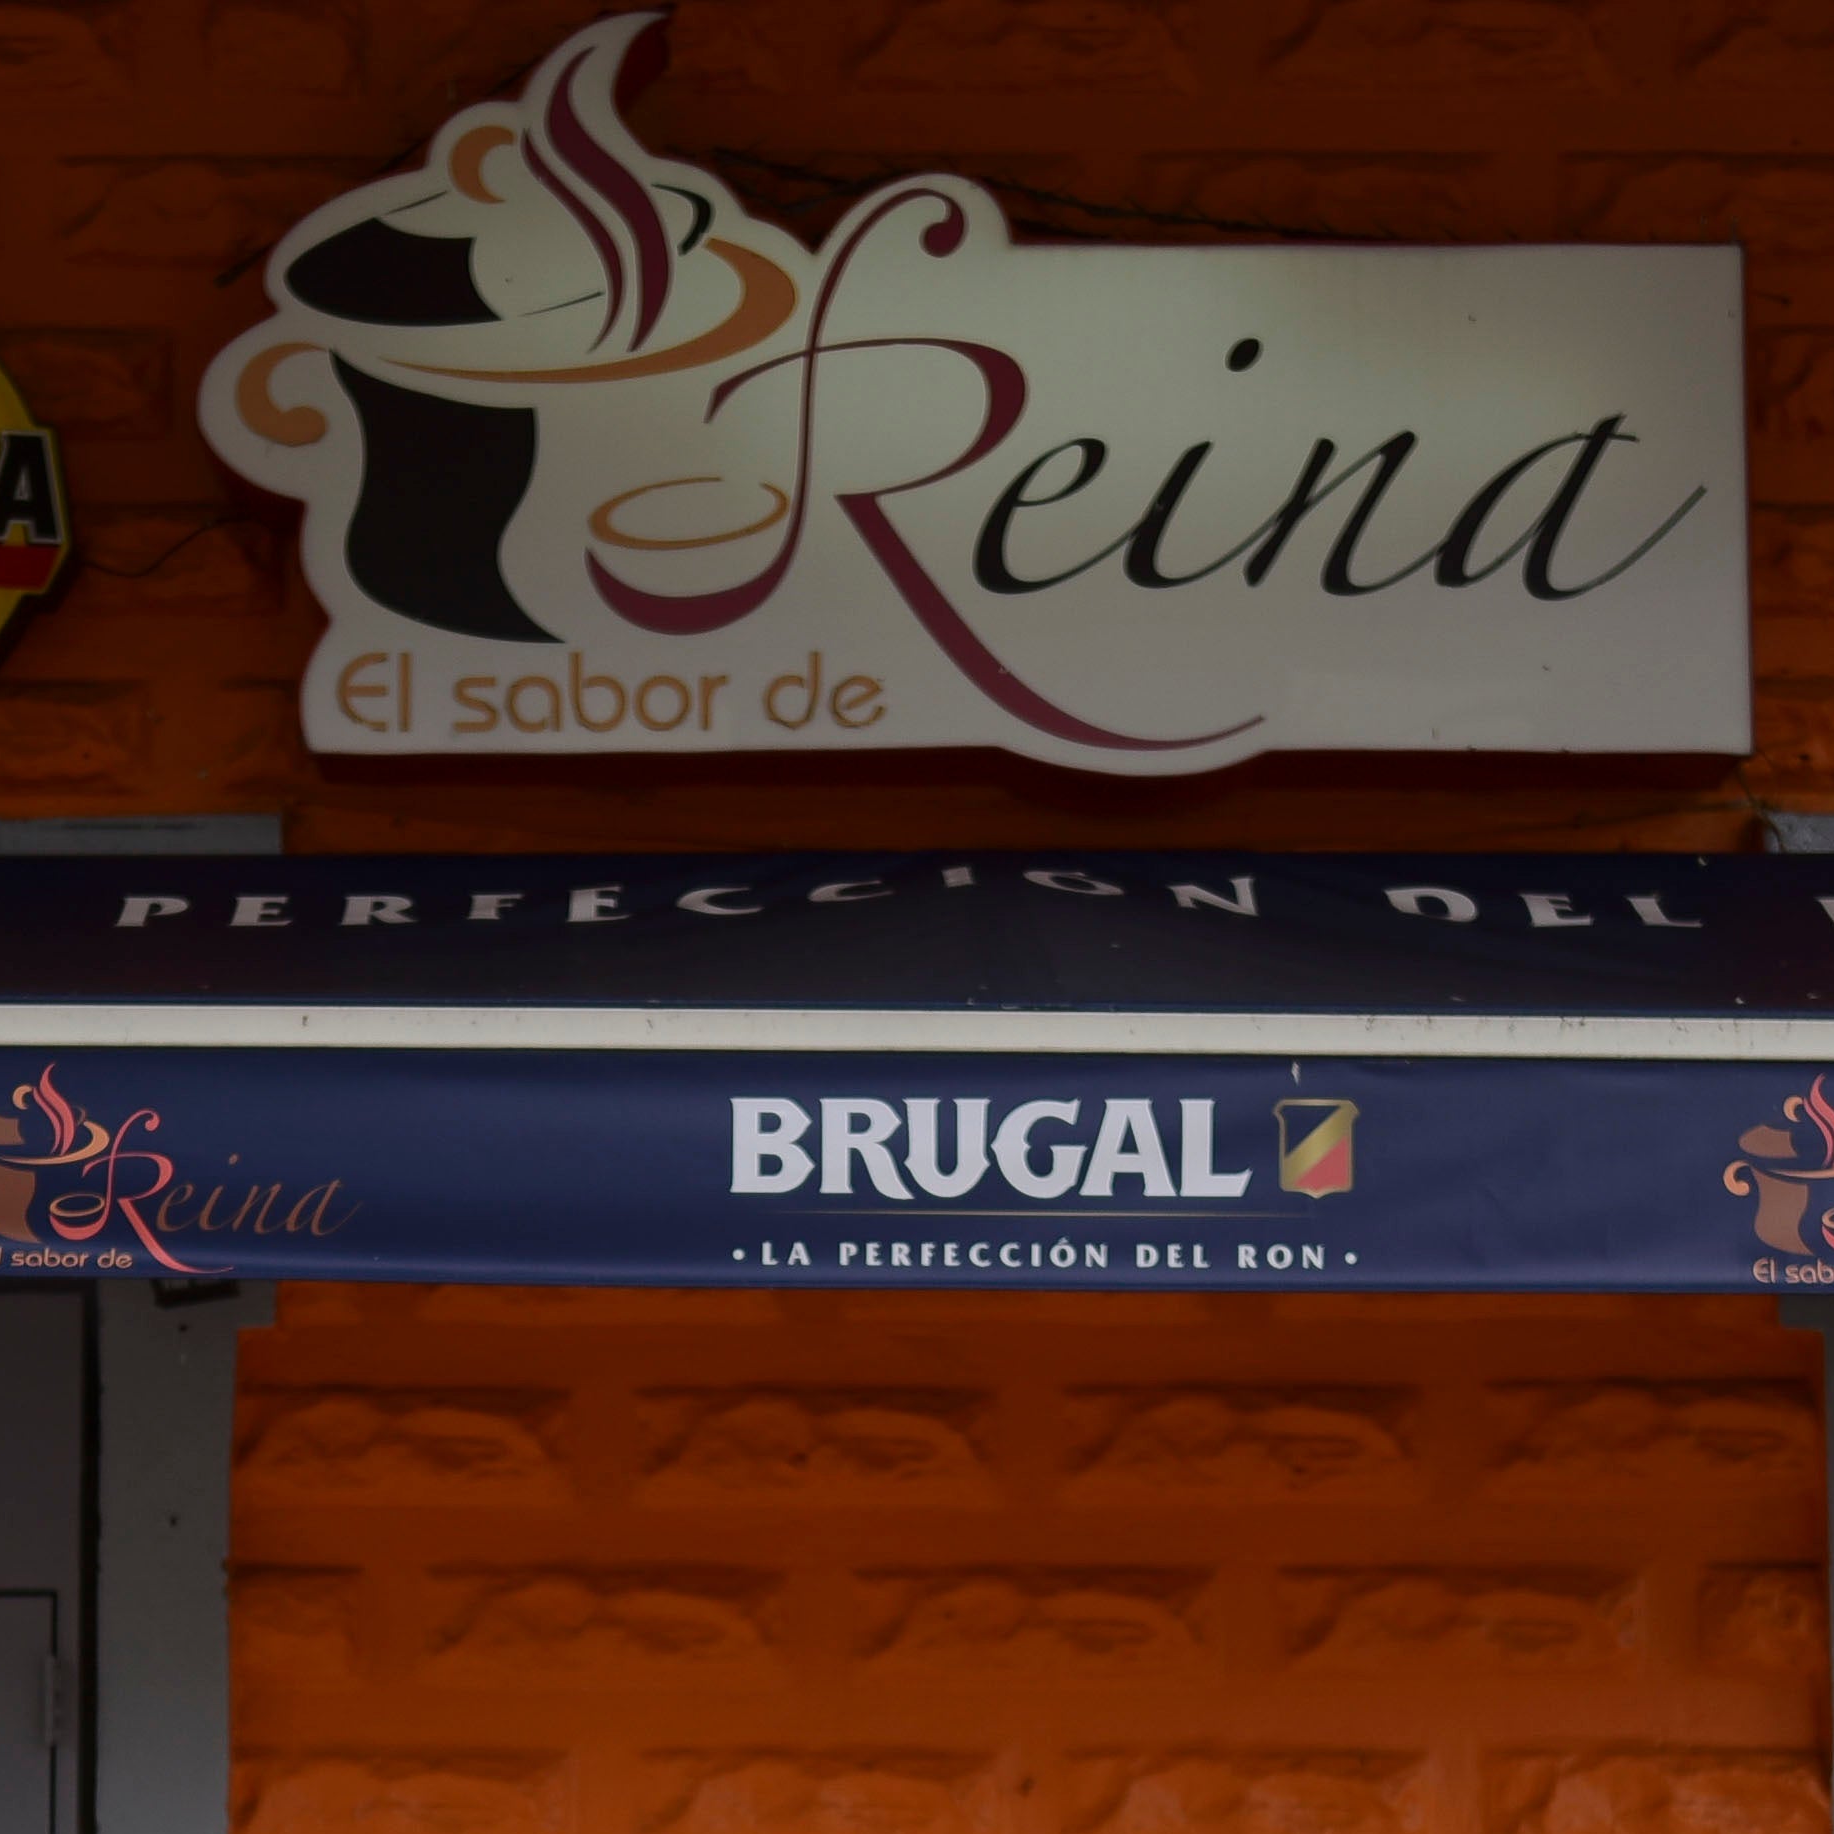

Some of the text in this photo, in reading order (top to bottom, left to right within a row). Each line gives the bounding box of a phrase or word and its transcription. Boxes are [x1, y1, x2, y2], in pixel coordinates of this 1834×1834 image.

[336, 188, 1706, 753] El sabor de Reina
[1383, 885, 1703, 929] DEL
[730, 1097, 1253, 1200] BRUGAL
[75, 1108, 361, 1274] Reina
[11, 1245, 90, 1268] sabor
[97, 1246, 133, 1269] de
[761, 1237, 1325, 1270] LA PERFECCIÓN DEL RON
[1752, 1258, 1776, 1284] El
